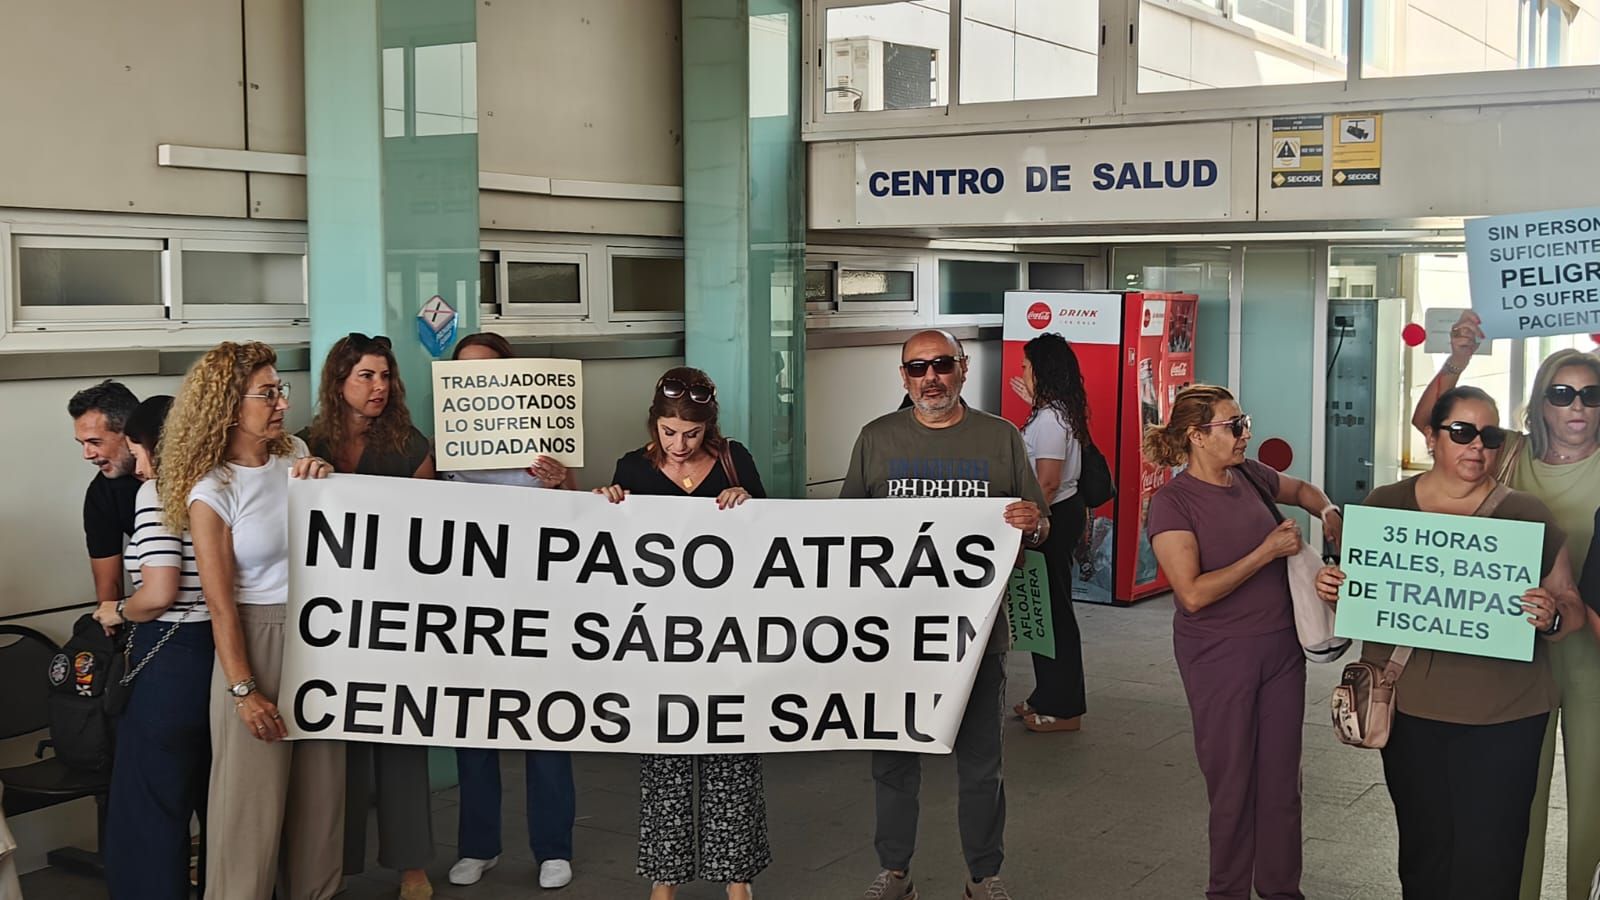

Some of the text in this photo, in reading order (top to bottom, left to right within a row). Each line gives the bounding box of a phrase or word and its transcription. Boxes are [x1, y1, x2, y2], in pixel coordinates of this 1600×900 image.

[869, 159, 1218, 197] CENTRO DE SALUD
[1287, 175, 1321, 183] SECOEX
[1347, 173, 1378, 181] SECOEX
[1488, 225, 1519, 241] SIN
[1490, 239, 1600, 262] SUFICIENTE
[1501, 262, 1600, 289] PELIGR
[1502, 288, 1599, 310] LO SUFRE
[1059, 309, 1098, 318] DRINK
[441, 373, 576, 389] TRABAJADORES
[442, 395, 576, 413] AGODOTADOS
[445, 416, 575, 433] LO SUFREN LOS
[445, 438, 576, 456] CIUDADANOS
[305, 509, 996, 589] NI UN PASO ATRÁS
[1383, 525, 1498, 553] 35 HORAS
[1348, 548, 1532, 584] REALES, BASTA
[1015, 583, 1034, 640] AFLOJA
[1028, 568, 1045, 638] CARTERA
[1348, 580, 1524, 617] DE TRAMPAS
[299, 597, 549, 658] CIERRE
[571, 603, 890, 663] SÁBADOS
[1376, 610, 1490, 640] FISCALES
[294, 679, 631, 744] CENTROS
[657, 693, 745, 744] DE
